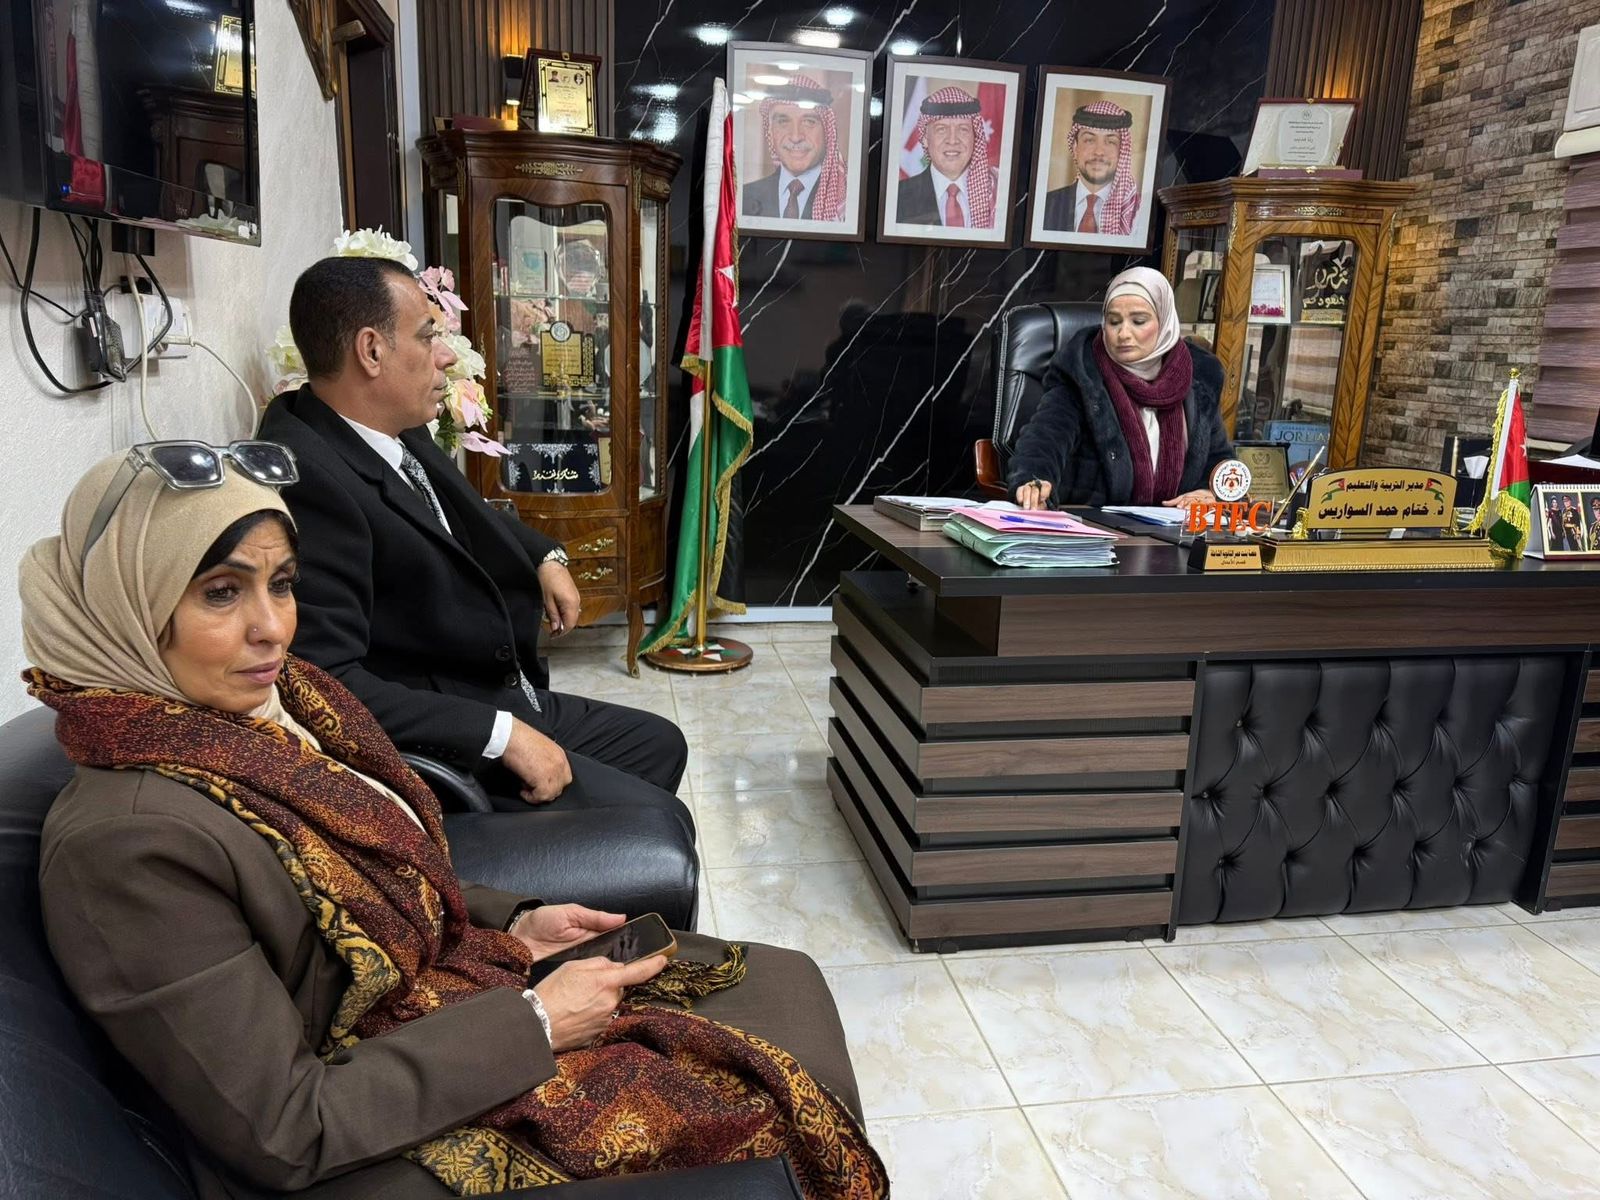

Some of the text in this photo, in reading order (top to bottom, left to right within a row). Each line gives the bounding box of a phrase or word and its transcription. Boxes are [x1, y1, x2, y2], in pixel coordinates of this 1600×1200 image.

[1346, 479, 1424, 492] مدير التربية والتعليم
[1186, 501, 1272, 533] BTEC
[1318, 502, 1373, 520] السواريس
[1376, 504, 1398, 517] حمد
[1402, 502, 1429, 520] ختام
